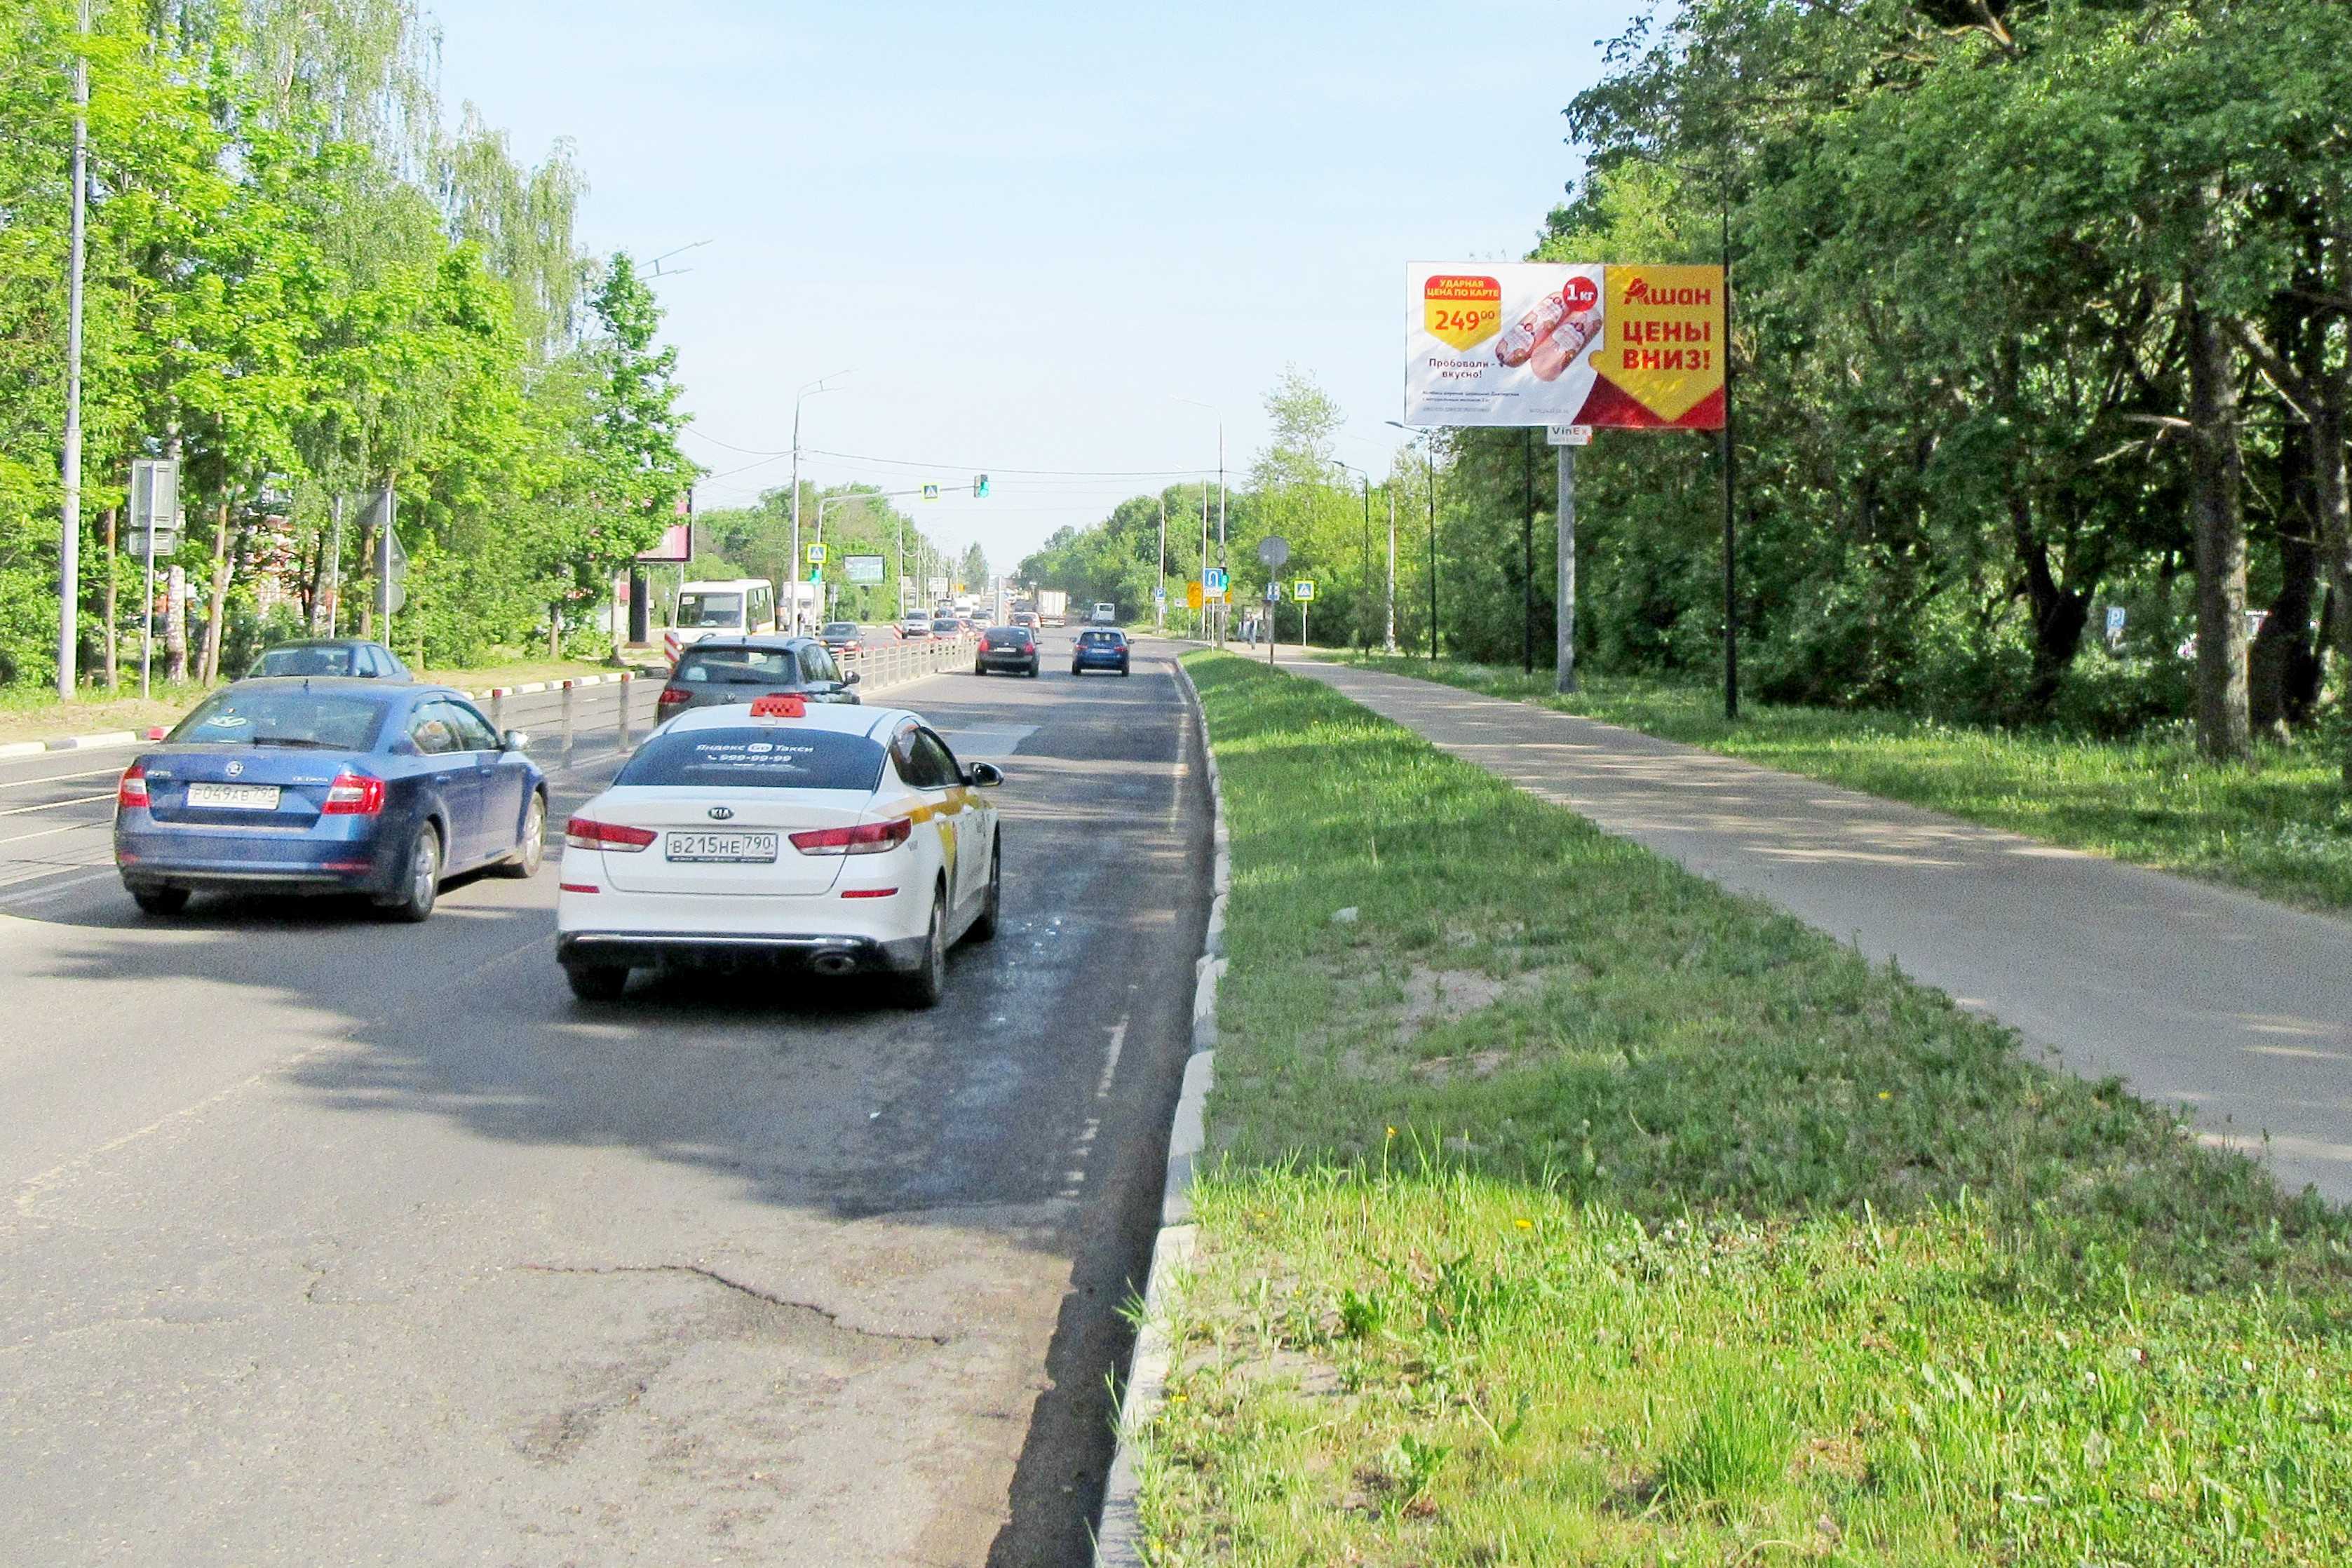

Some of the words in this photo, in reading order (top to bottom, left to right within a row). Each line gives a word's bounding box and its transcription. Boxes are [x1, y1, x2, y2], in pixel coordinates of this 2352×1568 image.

[1440, 279, 1485, 288] УДАРНАЯ
[1427, 288, 1454, 297] ЦЕНА
[1567, 284, 1578, 301] 1
[1579, 291, 1594, 301] кг
[1623, 277, 1711, 305] Ашан
[1435, 310, 1480, 331] 249
[1623, 320, 1711, 346] ЦЕНЫ
[1429, 358, 1489, 367] Пробовали
[1623, 349, 1711, 370] ВНИЗ!
[1442, 370, 1482, 379] вкусно!
[696, 743, 745, 752] Яндекс
[710, 809, 731, 818] KIA
